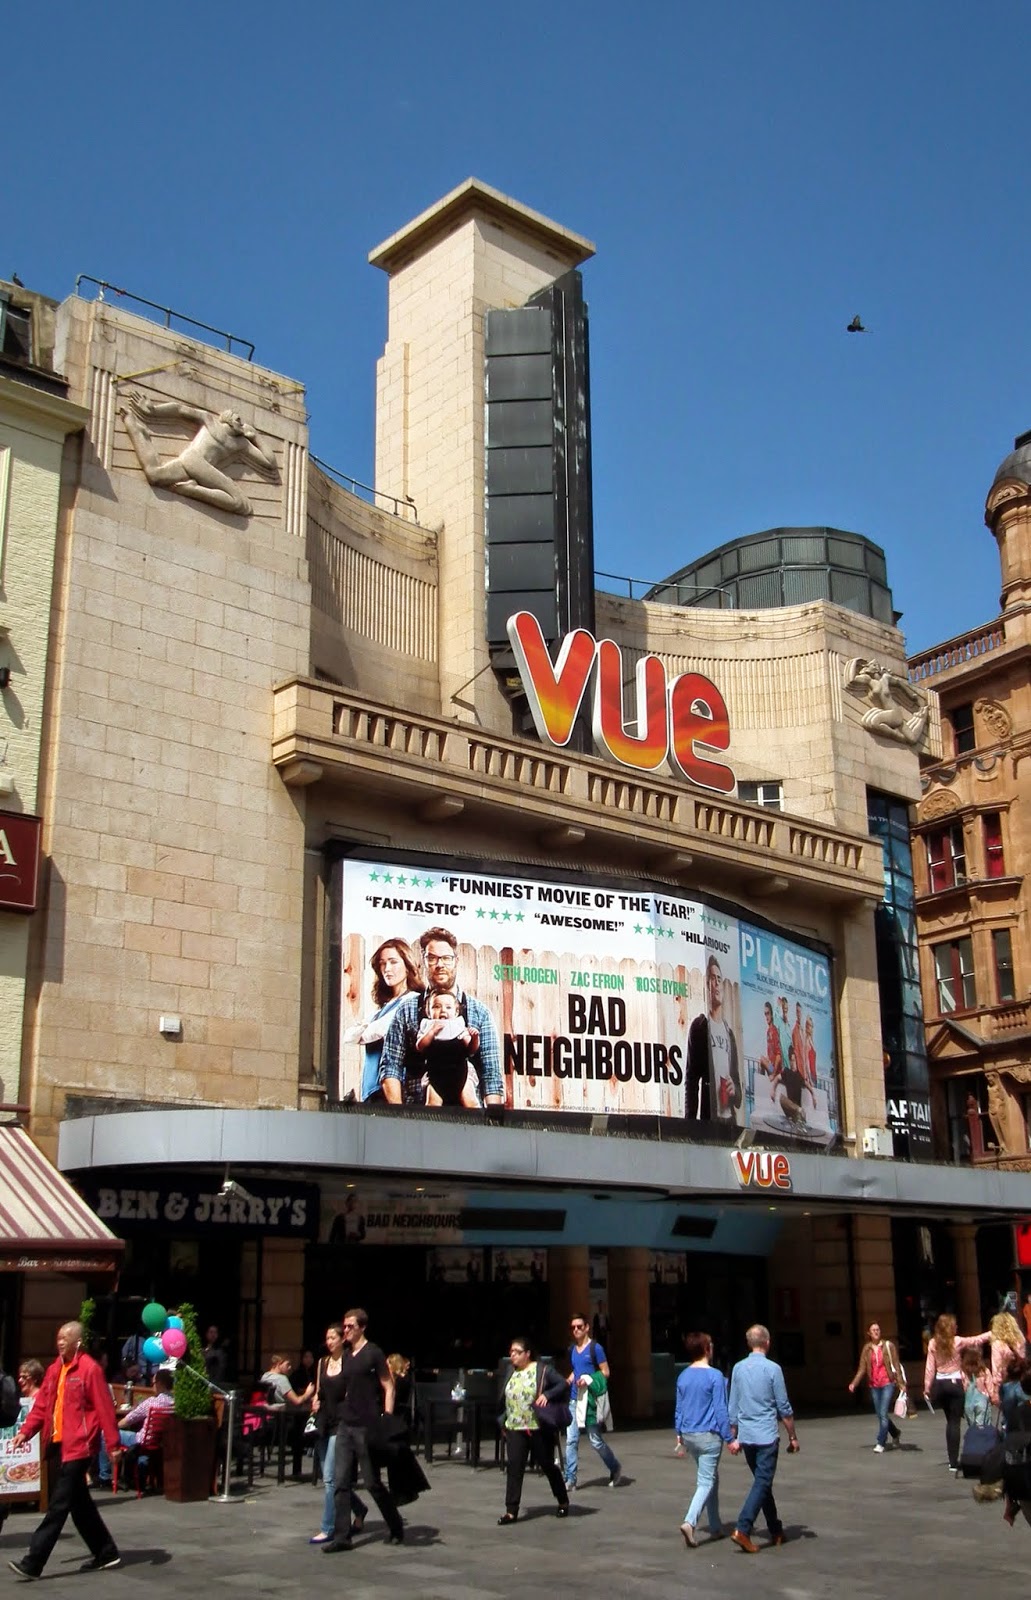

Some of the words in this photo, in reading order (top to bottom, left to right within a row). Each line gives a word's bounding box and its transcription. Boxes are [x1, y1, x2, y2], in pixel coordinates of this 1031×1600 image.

[365, 895, 466, 916] “FANTASTIC”
[441, 876, 534, 901] “FUNNIEST
[538, 887, 591, 907] MOVIE
[594, 893, 615, 909] OF
[618, 895, 652, 913] THE
[653, 899, 695, 920] YEAR!”
[534, 912, 625, 932] “AWESOME!”
[494, 964, 521, 982] SETH
[523, 967, 558, 985] ROGEN
[741, 932, 828, 998] PLASTIC
[570, 970, 591, 988] ZAC
[592, 973, 625, 991] EFRON
[635, 976, 661, 994] ROSE
[662, 978, 689, 998] BYRNE
[567, 993, 627, 1037] BAD
[503, 1033, 683, 1086] NEIGHBOURS
[97, 1187, 160, 1220] BEN
[163, 1191, 190, 1222] &
[367, 1213, 391, 1228] BAD
[392, 1213, 464, 1229] NEIGHBOURS
[17, 1256, 40, 1268] Bar
